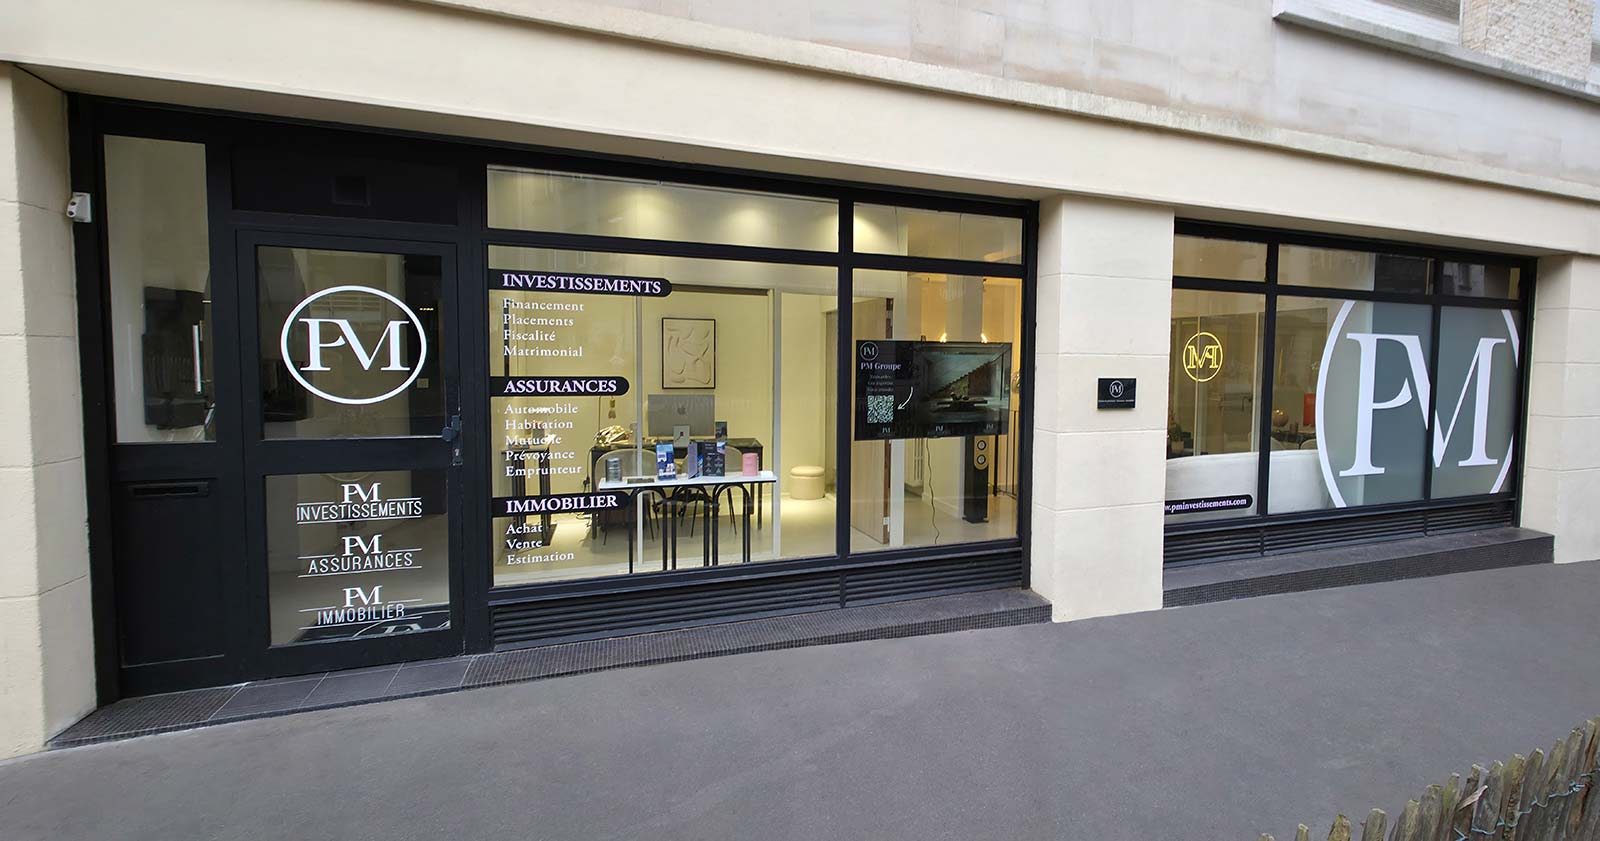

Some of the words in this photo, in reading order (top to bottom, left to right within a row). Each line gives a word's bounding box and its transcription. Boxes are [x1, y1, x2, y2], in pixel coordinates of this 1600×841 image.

[502, 273, 662, 294] INVESTISSEMENTS
[503, 298, 584, 312] Financement
[504, 314, 574, 327] Placements
[504, 329, 556, 342] Fiscalité
[299, 318, 411, 372] PM
[504, 345, 583, 357] Matrimonial
[860, 362, 872, 370] PM
[874, 362, 902, 371] Groupe
[504, 380, 617, 394] ASSURANCES
[504, 402, 578, 414] Automobile
[1339, 333, 1506, 477] PM
[505, 419, 574, 430] Habitation
[505, 450, 575, 463] Prévoyance
[505, 464, 582, 479] Emprunteur
[341, 482, 381, 504] PM
[506, 494, 618, 513] IMMOBILIER
[296, 501, 422, 521] INVESTISSEMENTS
[505, 522, 543, 535] Achat
[342, 534, 382, 556] PM
[506, 538, 542, 550] Vente
[308, 552, 413, 574] ASSURANCES
[507, 552, 575, 566] Estimation
[343, 585, 383, 608] PM
[318, 603, 405, 625] IMMOBILIER
